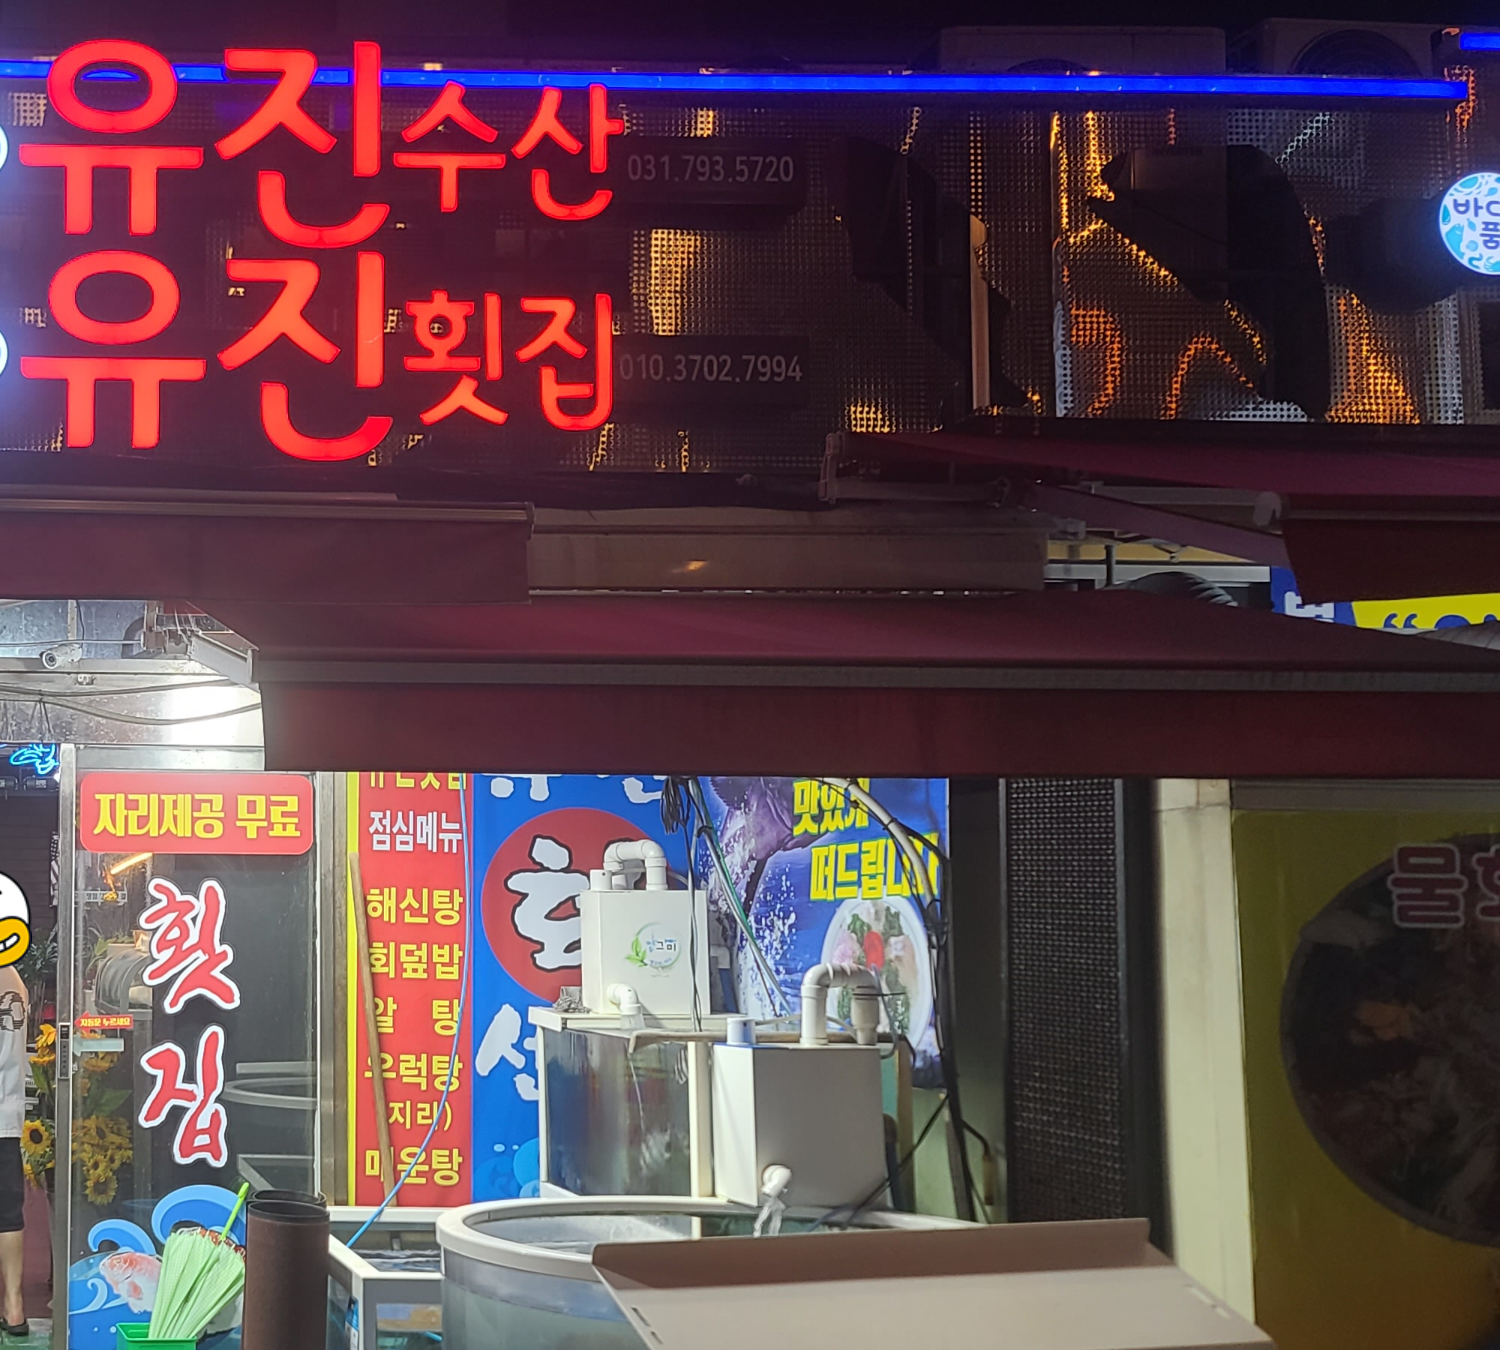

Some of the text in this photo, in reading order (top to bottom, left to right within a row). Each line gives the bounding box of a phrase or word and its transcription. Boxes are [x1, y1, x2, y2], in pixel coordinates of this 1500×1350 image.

[626, 154, 795, 185] 031.793.5720
[618, 353, 803, 384] 010.3702.7994
[93, 793, 301, 839] 자리제공 무료
[368, 810, 463, 854] 점심메뉴
[366, 887, 464, 926] 해신탕
[369, 942, 464, 981] 회덮밥
[80, 1017, 131, 1027] 자동문 누르세요
